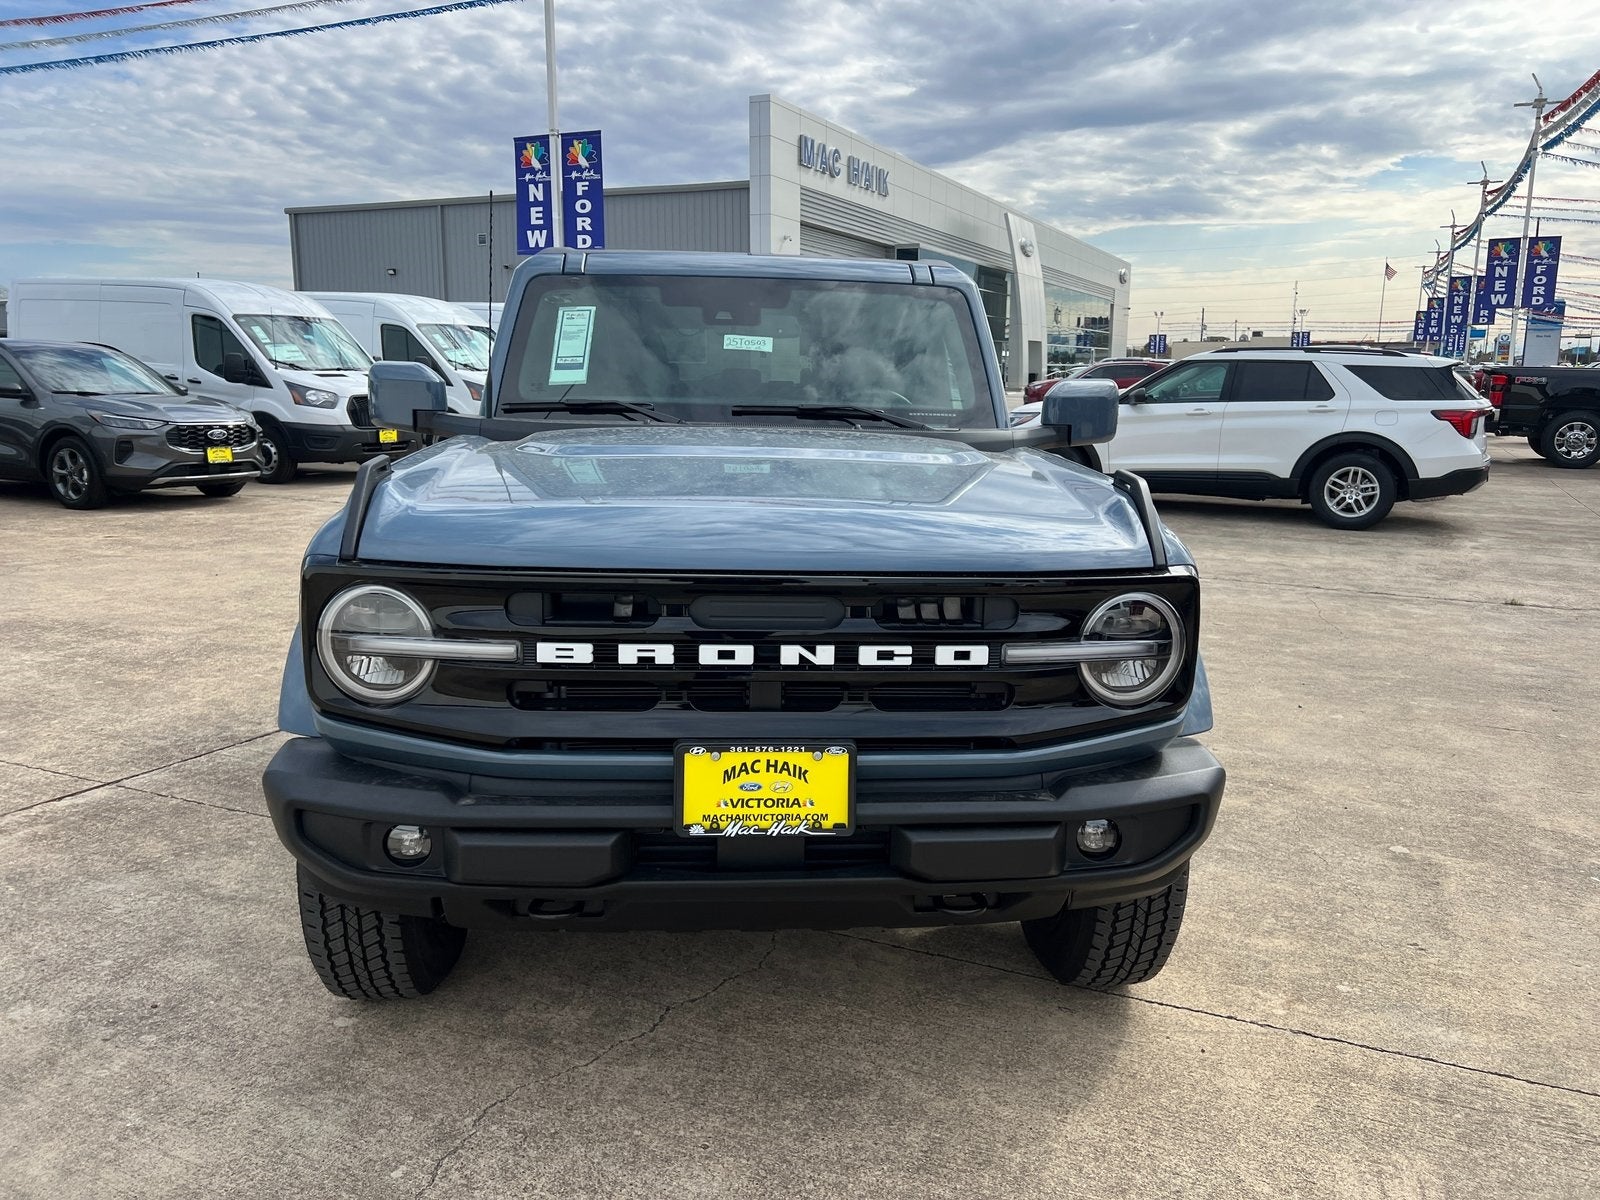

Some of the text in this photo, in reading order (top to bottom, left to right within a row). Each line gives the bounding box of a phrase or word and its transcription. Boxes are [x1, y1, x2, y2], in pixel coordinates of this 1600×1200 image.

[798, 135, 889, 197] MAC HAIK
[527, 183, 547, 248] NEW
[575, 181, 592, 249] FORD
[1490, 266, 1508, 305] NEW
[1531, 265, 1547, 305] FORD
[1450, 295, 1463, 323] NEW
[1429, 312, 1439, 333] NEW
[536, 642, 989, 665] BRONCO
[722, 759, 809, 784] MAC HAIK
[740, 782, 762, 791] Ford
[729, 797, 801, 809] VICTORIA
[702, 813, 829, 823] MACHAIKVICTORIA.COM
[723, 819, 812, 837] Mac Haik
